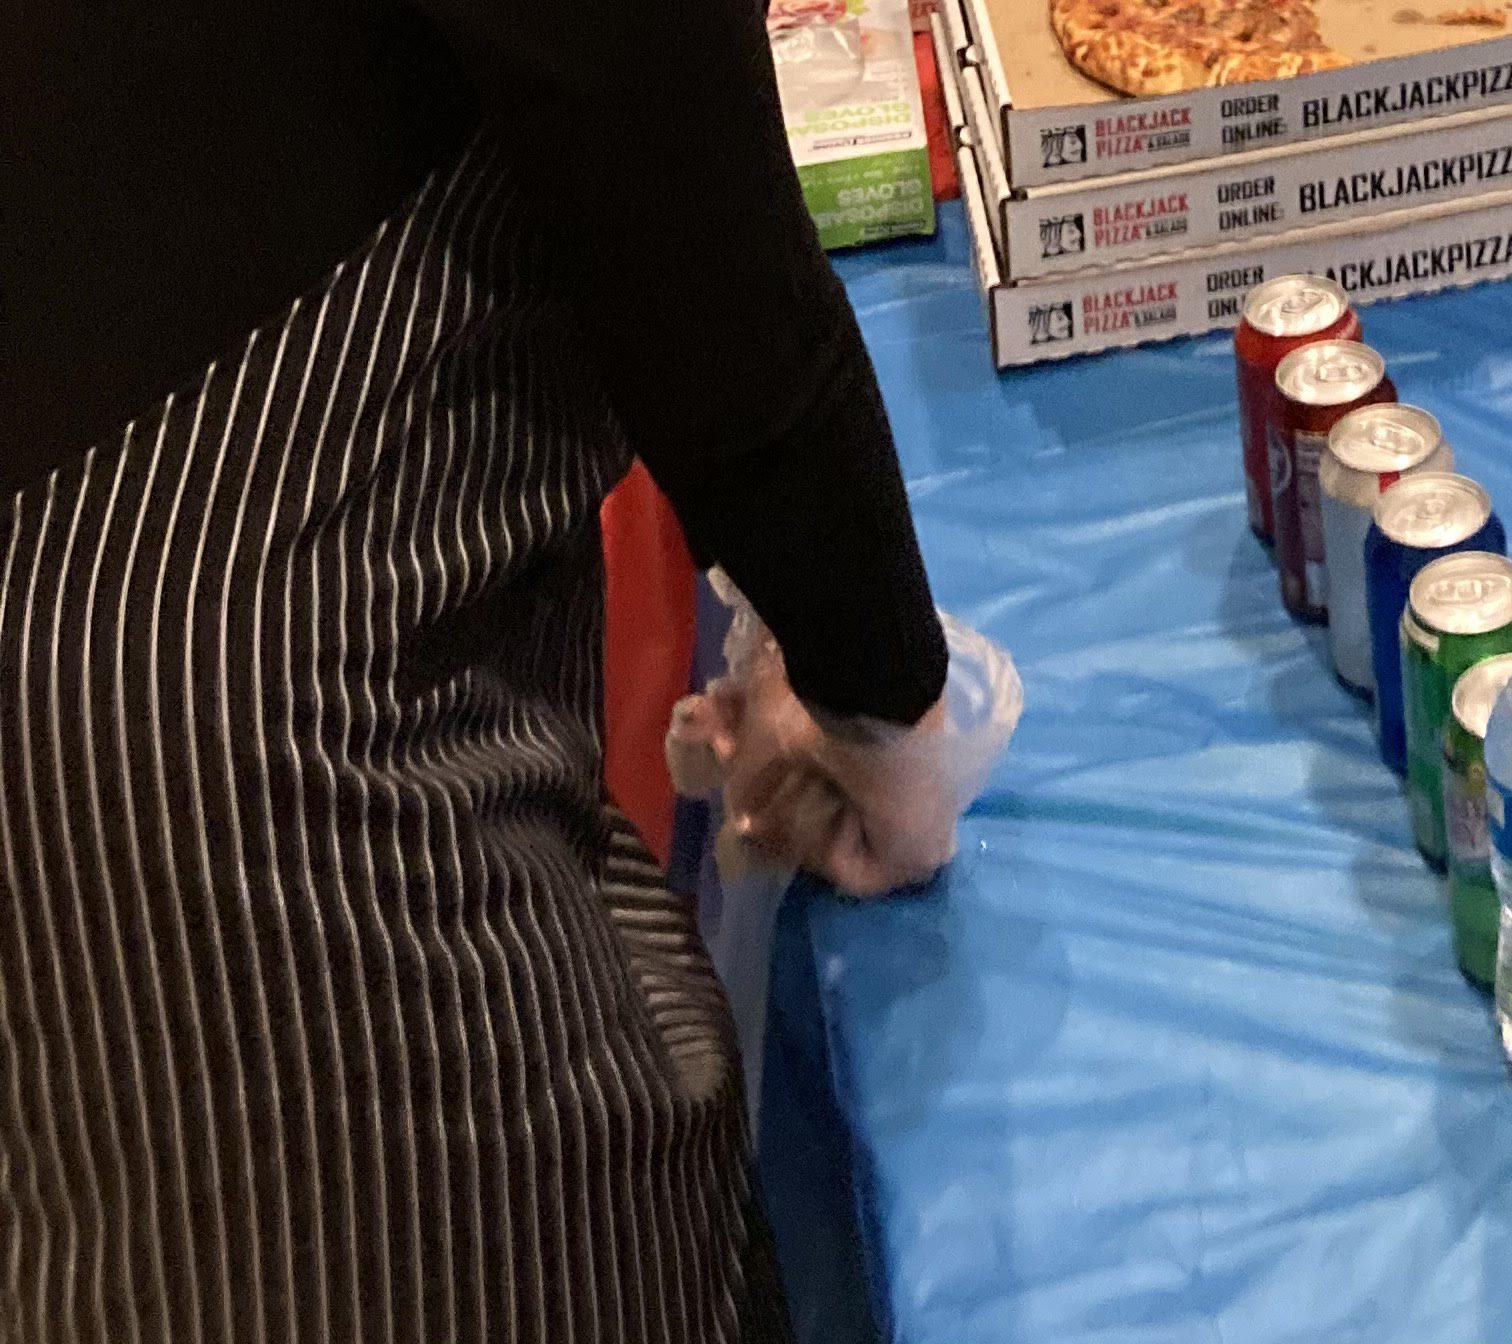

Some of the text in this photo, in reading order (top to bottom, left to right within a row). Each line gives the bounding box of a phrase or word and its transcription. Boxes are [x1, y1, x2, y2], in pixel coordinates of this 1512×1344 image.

[1221, 94, 1279, 118] ORDER
[788, 111, 911, 138] DISPOSA
[1095, 107, 1191, 137] BLACKJACK
[1096, 135, 1142, 159] PIZZA
[1217, 176, 1275, 203] ORDER
[813, 196, 924, 229] DISPOSAB
[1093, 193, 1188, 226] BLACKJACK
[1094, 221, 1140, 247] PIZZA
[1207, 266, 1263, 292] ORDER
[1083, 282, 1177, 314] BLACKJACK
[1084, 310, 1130, 334] PIZZA
